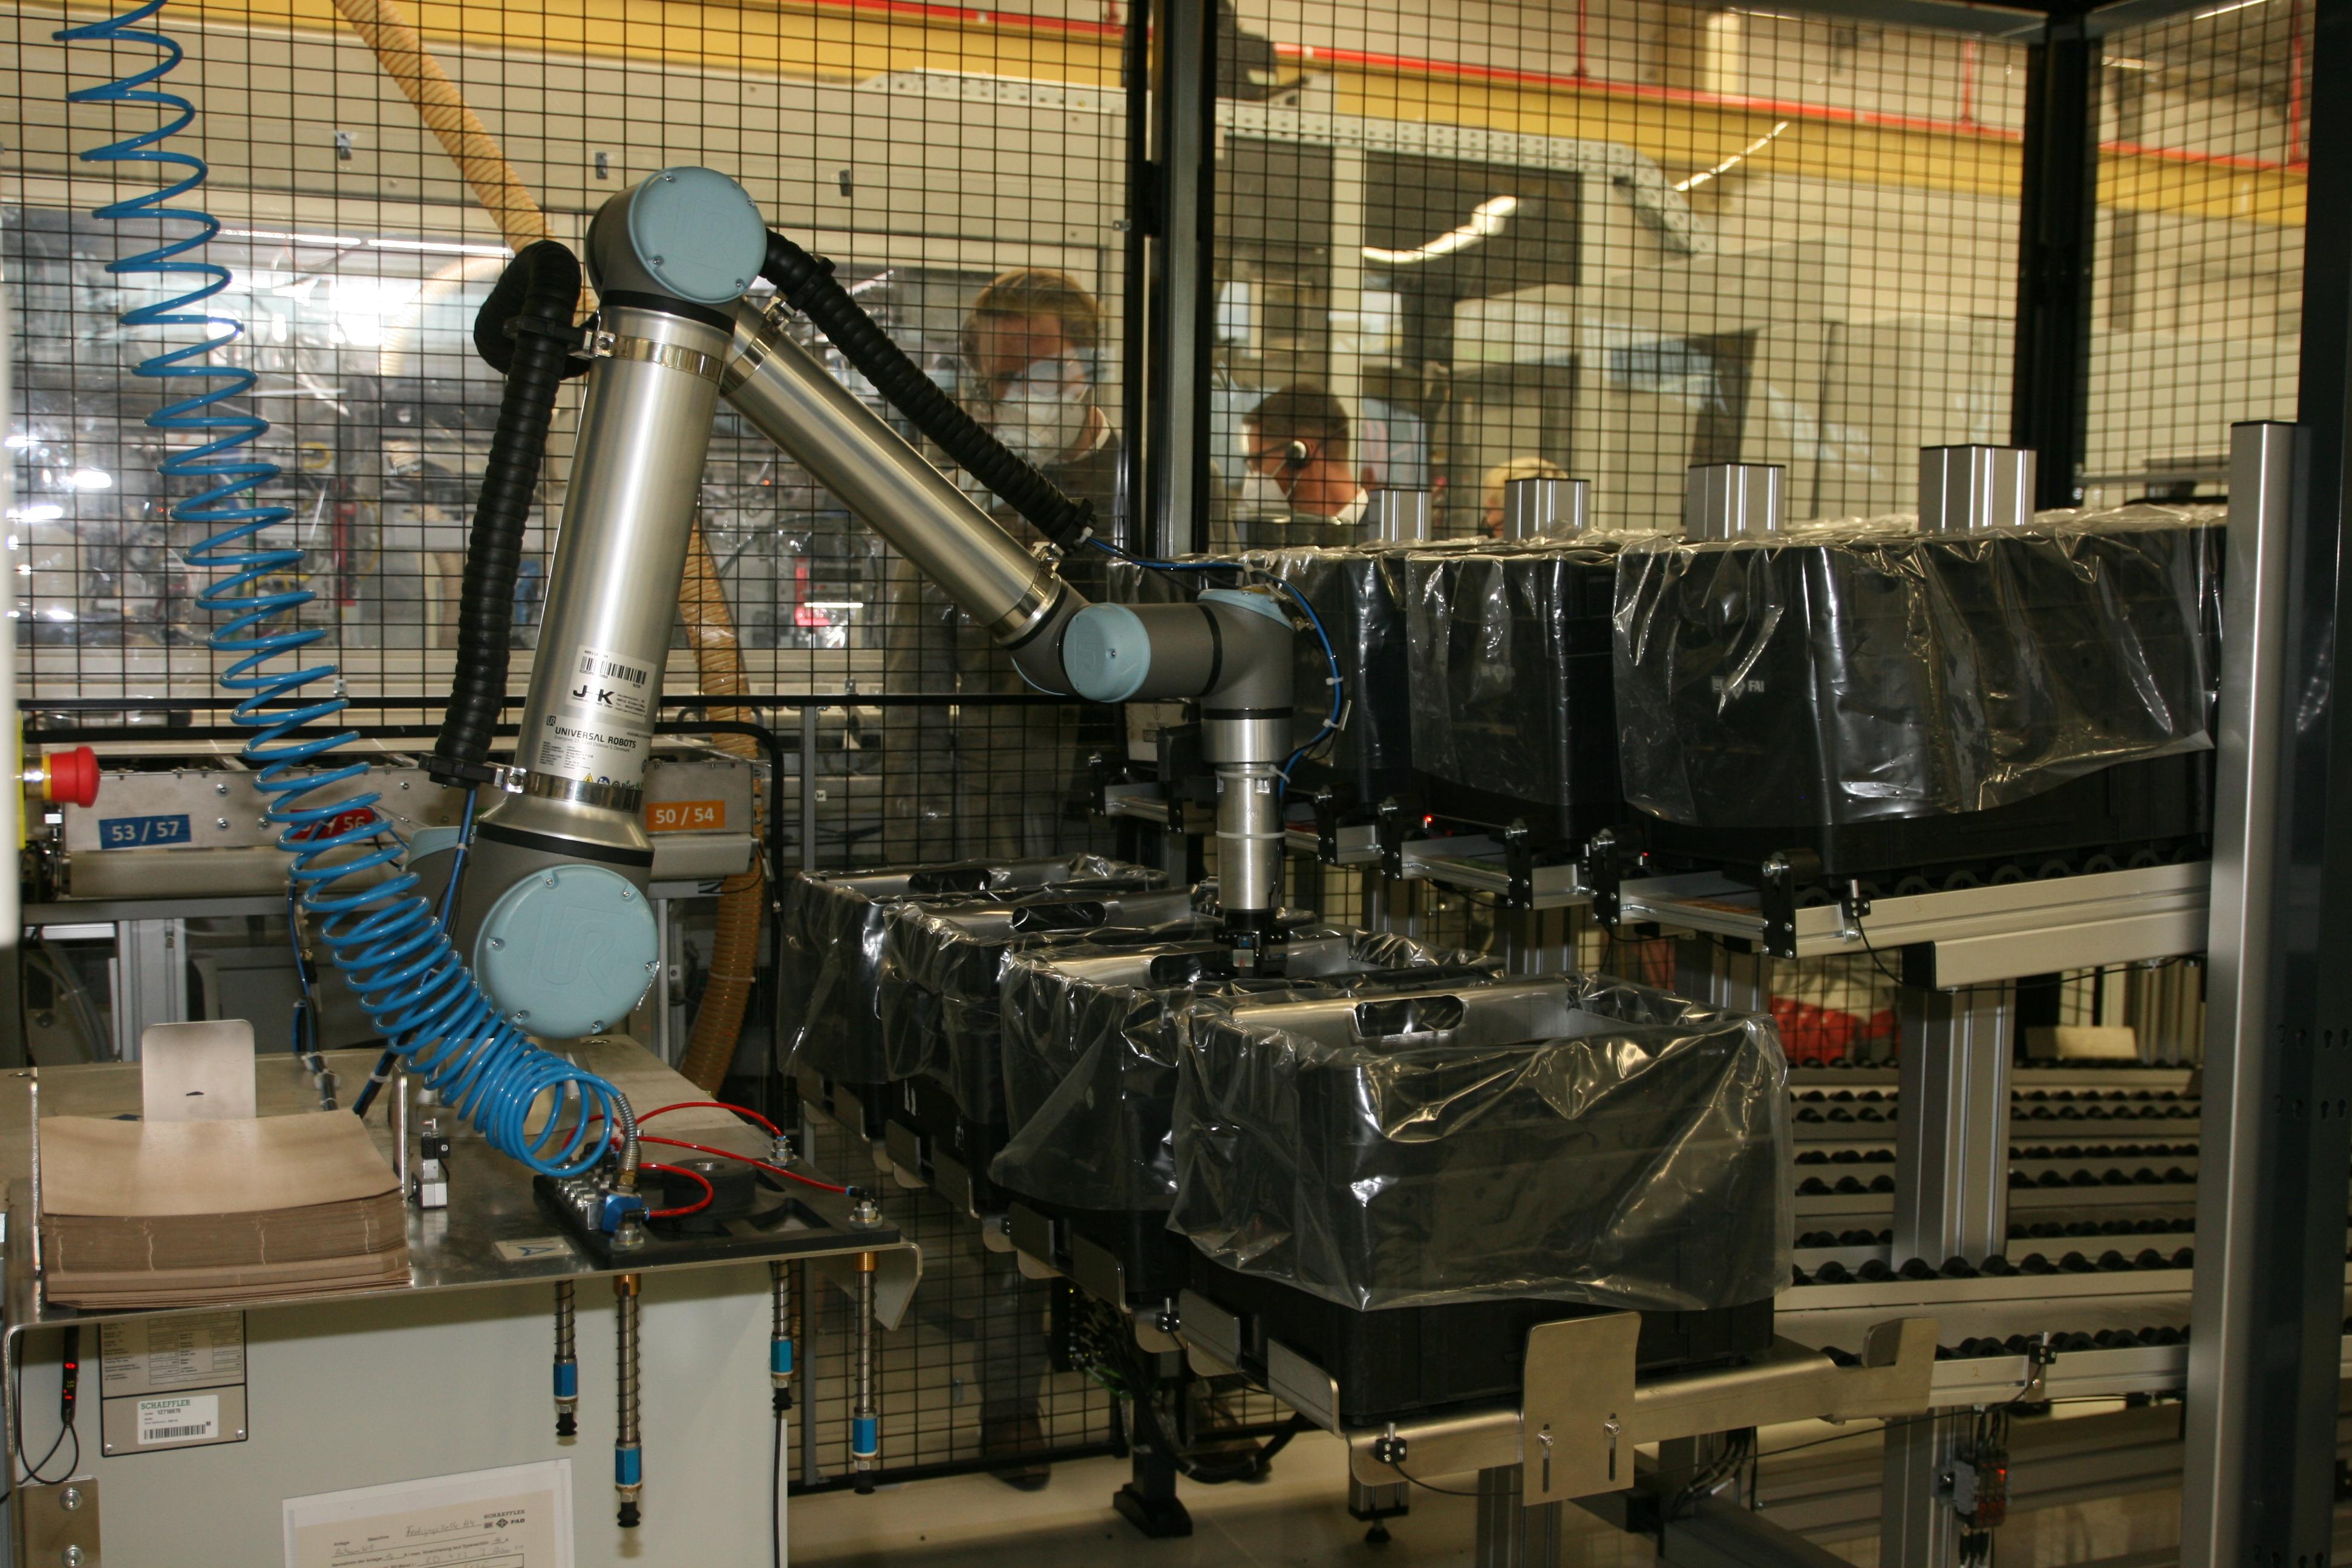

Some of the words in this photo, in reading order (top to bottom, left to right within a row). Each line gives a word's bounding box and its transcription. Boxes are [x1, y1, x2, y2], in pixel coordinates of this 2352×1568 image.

[555, 727, 604, 742] UNIVERSAL
[608, 736, 636, 748] ROBOTS
[655, 809, 676, 824] 50
[681, 806, 689, 826] /
[694, 808, 714, 822] 54
[112, 825, 136, 841] 53
[141, 821, 150, 842] /
[157, 820, 179, 837] 57
[141, 1399, 191, 1410] SCHAEFFLER
